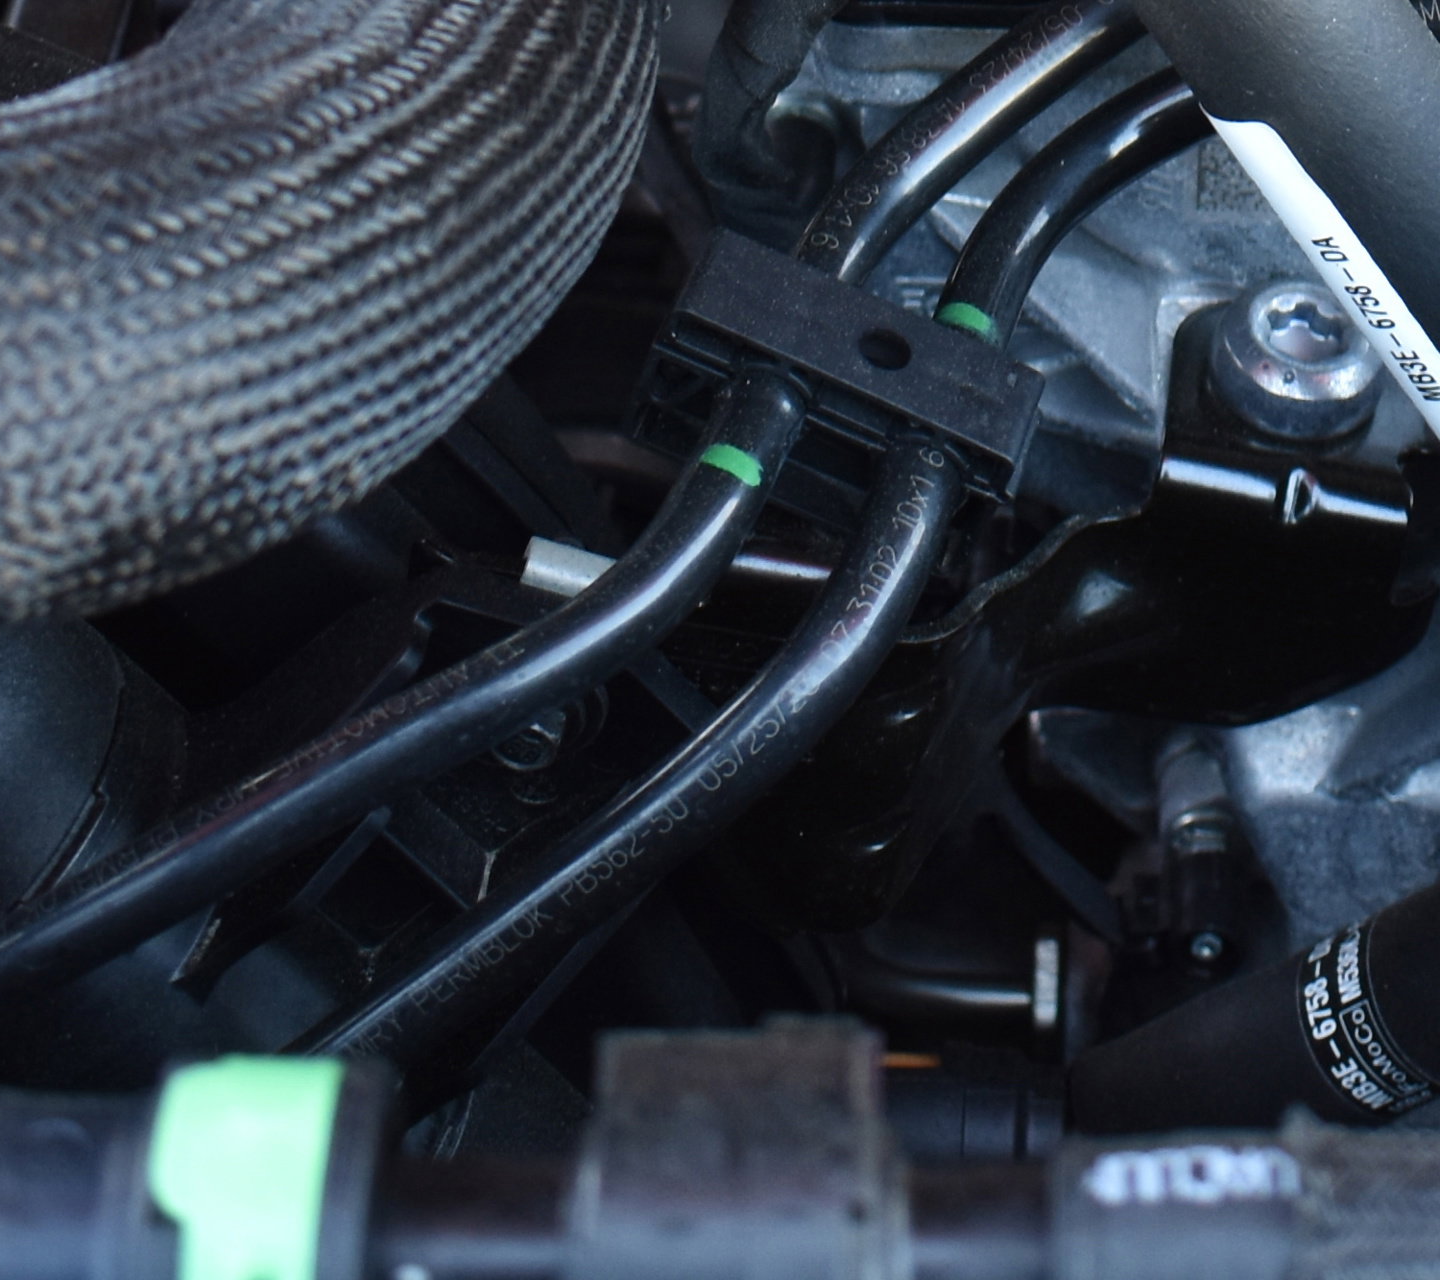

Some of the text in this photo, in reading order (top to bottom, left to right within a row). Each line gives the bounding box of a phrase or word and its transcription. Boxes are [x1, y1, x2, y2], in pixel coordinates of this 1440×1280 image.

[267, 656, 479, 785] AUTOMOTIVE
[406, 897, 556, 1019] PERMBLOK
[552, 789, 694, 913] PB562-50
[1351, 1008, 1420, 1097] FoMoCo
